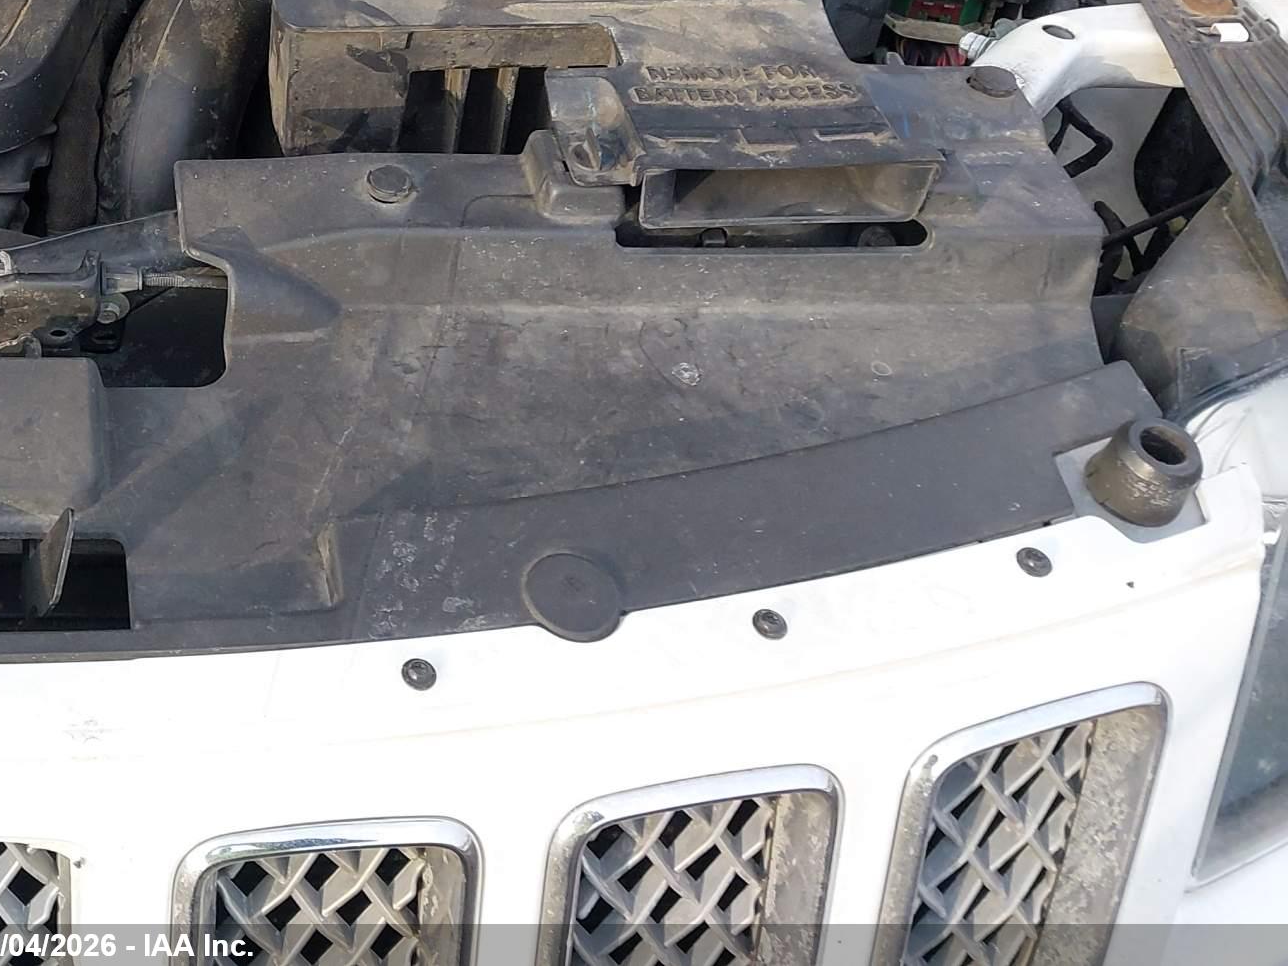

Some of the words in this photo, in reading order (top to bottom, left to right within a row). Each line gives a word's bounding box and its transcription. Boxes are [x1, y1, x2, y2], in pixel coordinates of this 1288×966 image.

[644, 65, 758, 82] REMOVE
[761, 64, 817, 80] FOR
[632, 87, 752, 104] BATTERY
[755, 82, 858, 102] ACCESS
